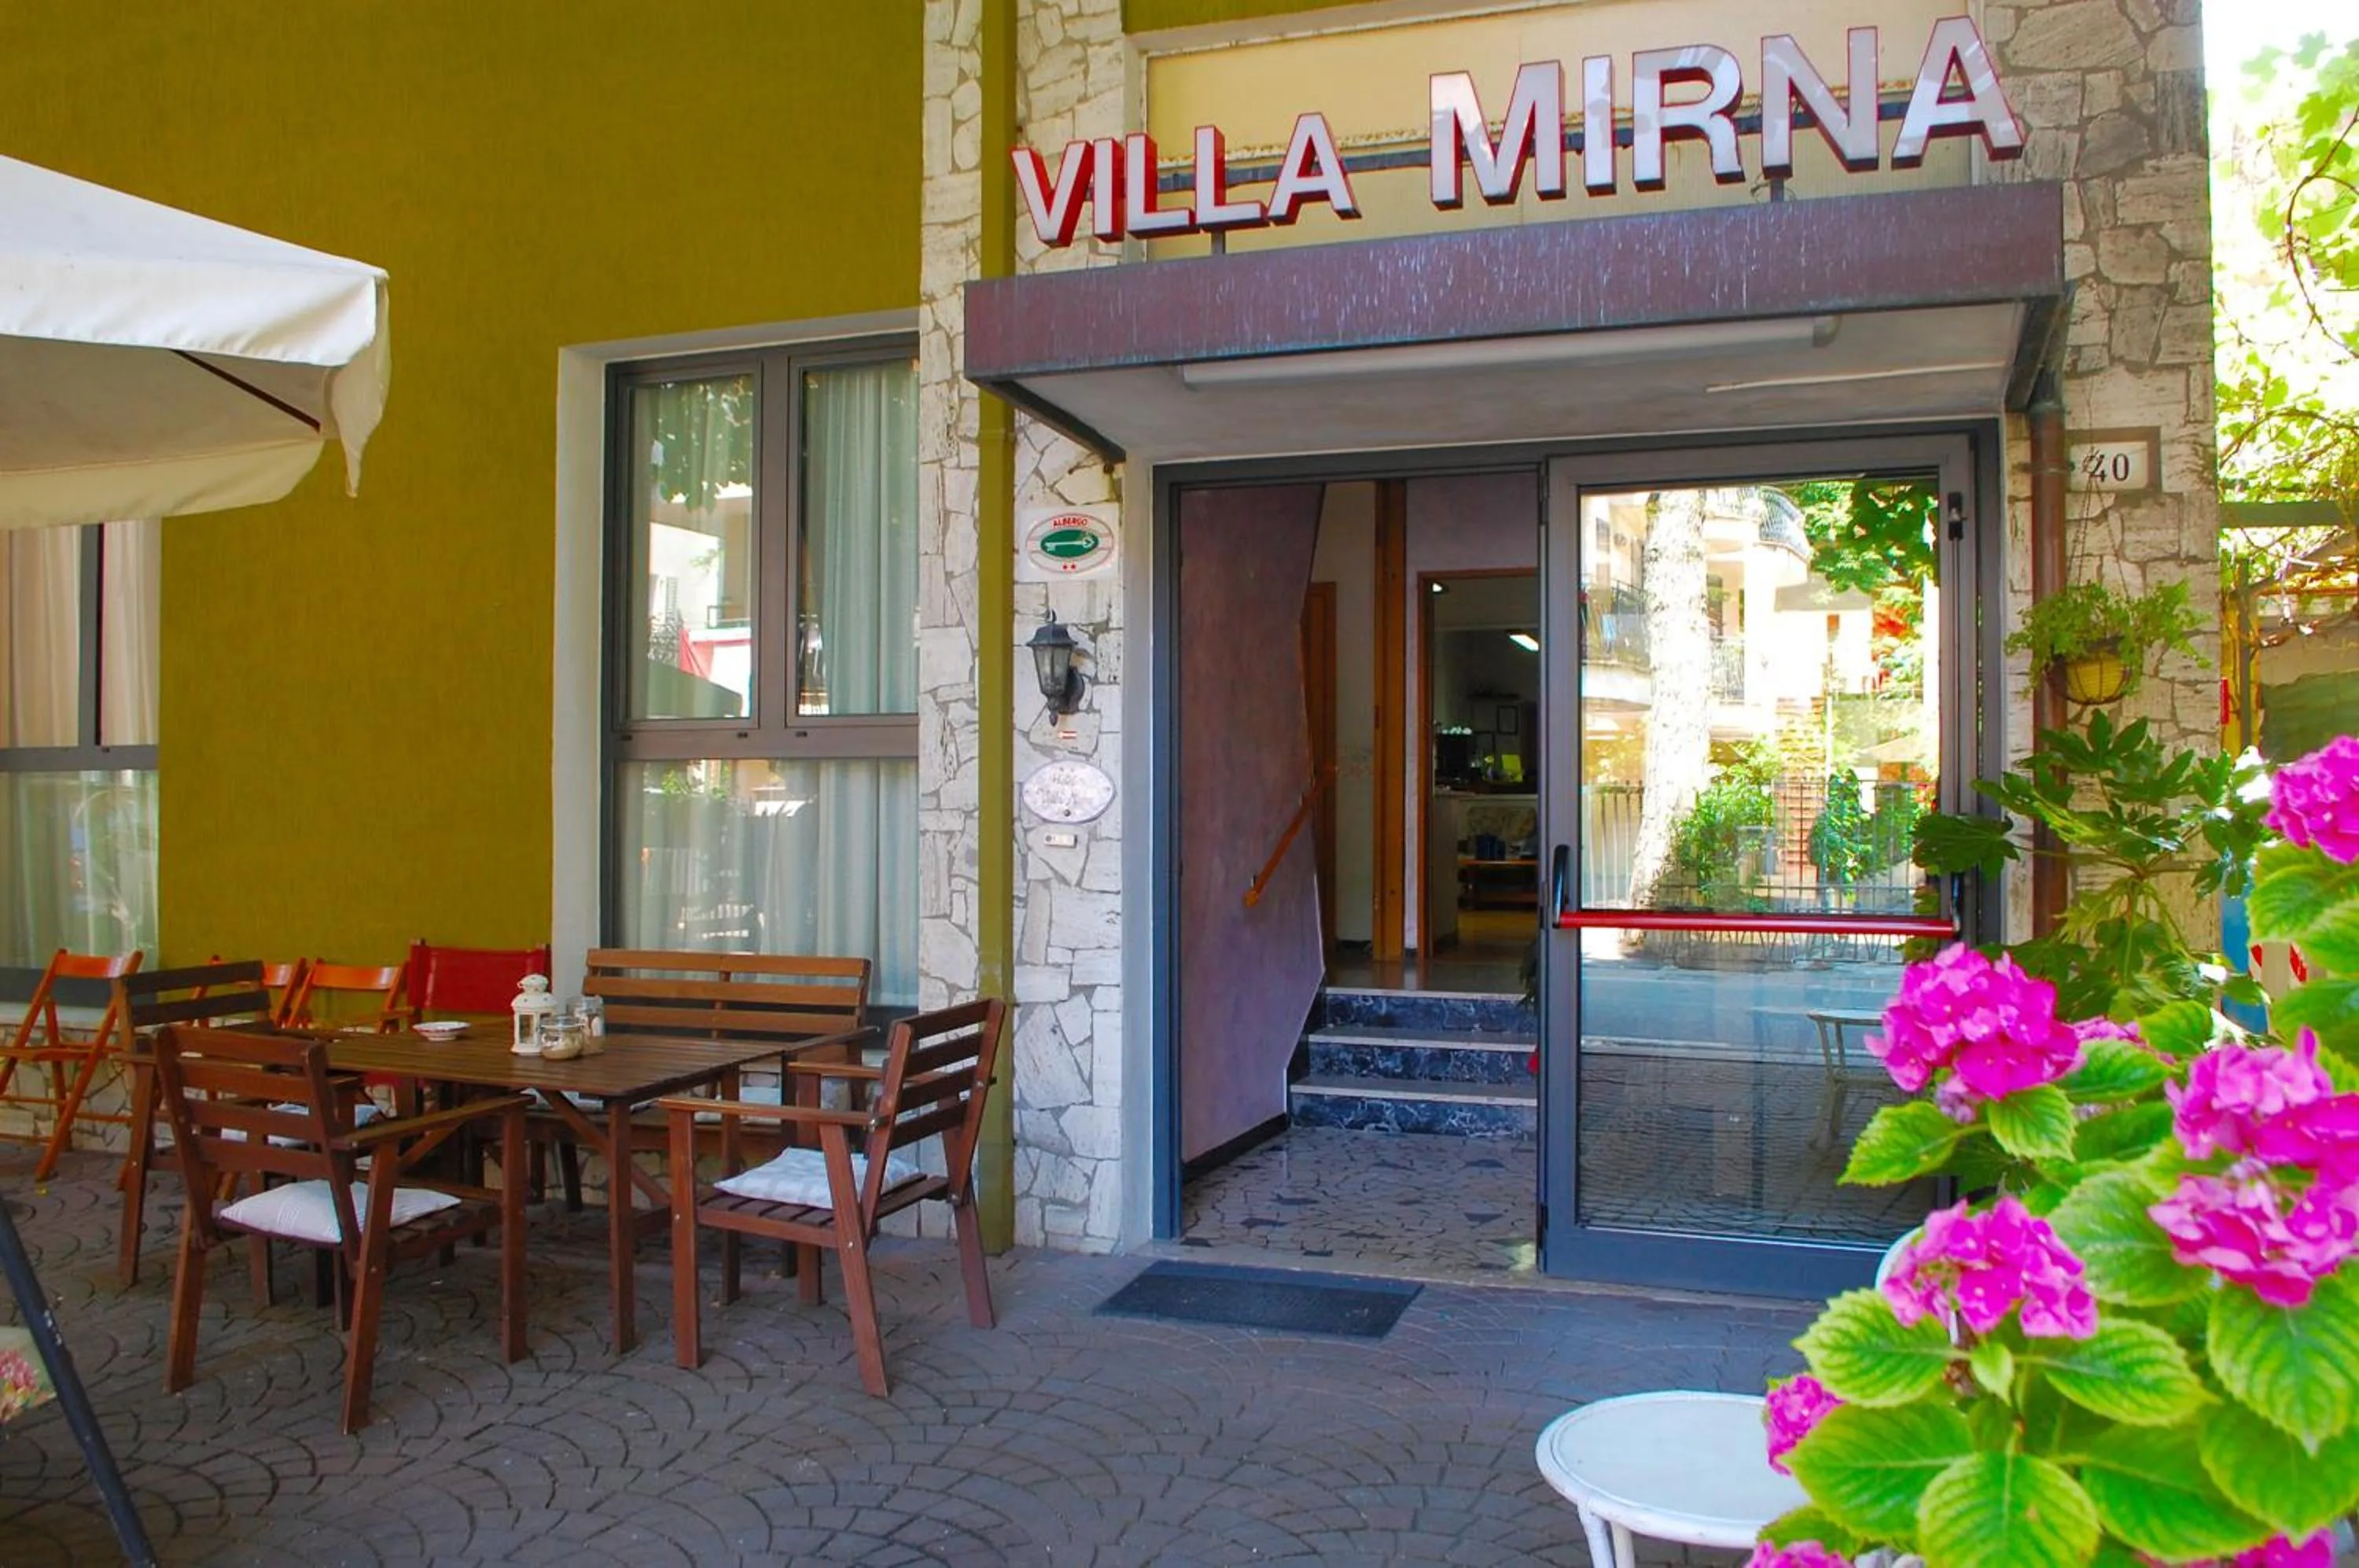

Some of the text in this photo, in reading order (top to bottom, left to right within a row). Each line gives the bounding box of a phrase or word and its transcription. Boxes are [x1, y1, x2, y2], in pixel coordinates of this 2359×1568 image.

[1011, 15, 2025, 247] VILLA MIRNA
[2089, 453, 2129, 482] 40
